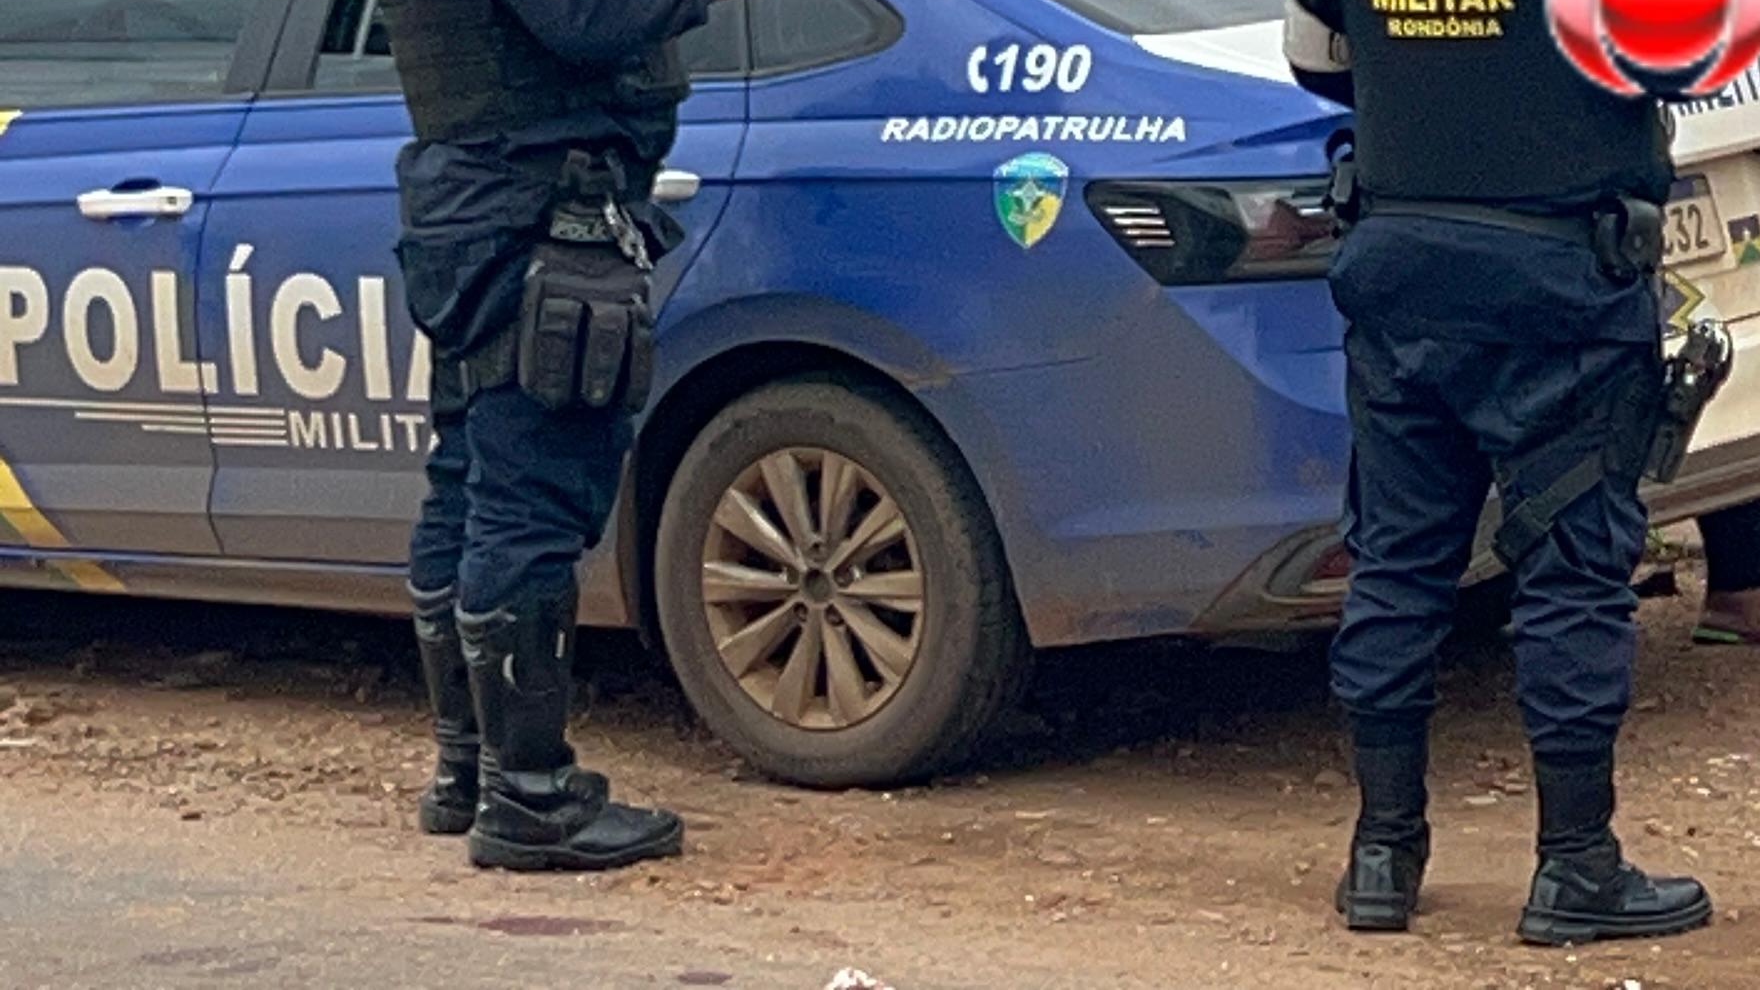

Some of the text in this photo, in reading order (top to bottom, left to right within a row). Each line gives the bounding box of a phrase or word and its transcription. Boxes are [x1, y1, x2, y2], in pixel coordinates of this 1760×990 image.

[1387, 15, 1504, 37] RONDÔNIA
[993, 43, 1092, 93] 190
[881, 116, 1187, 142] RADIOPATRULHA
[287, 410, 440, 452] MILIT
